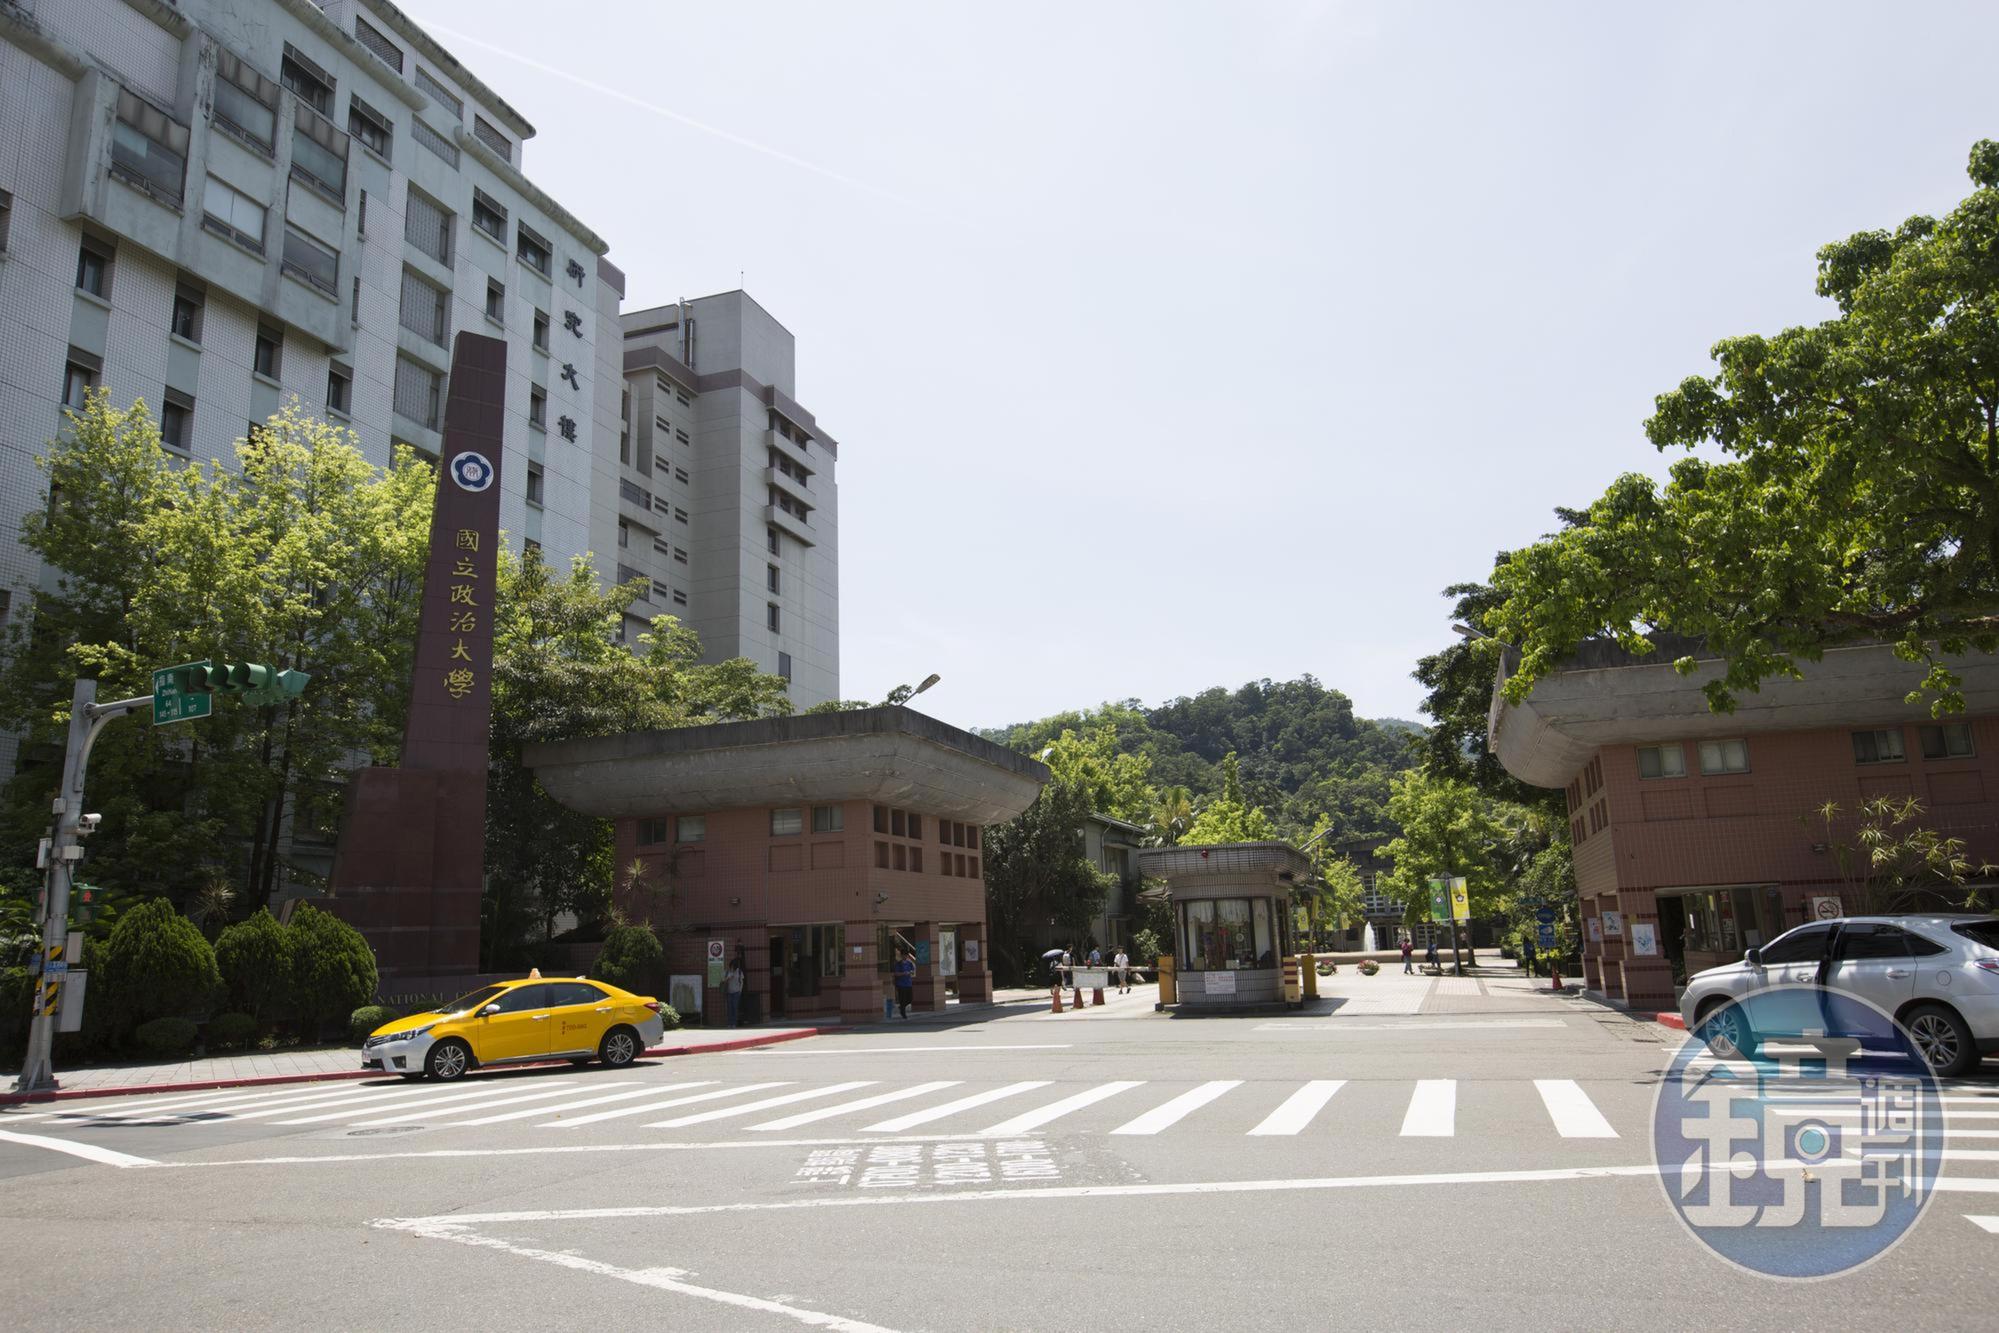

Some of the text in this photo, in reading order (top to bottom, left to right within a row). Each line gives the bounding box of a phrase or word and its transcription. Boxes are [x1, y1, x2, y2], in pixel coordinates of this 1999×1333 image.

[558, 258, 586, 444] 研究大樓
[443, 528, 480, 699] 國立政治大學
[377, 991, 447, 1004] NATIONAL
